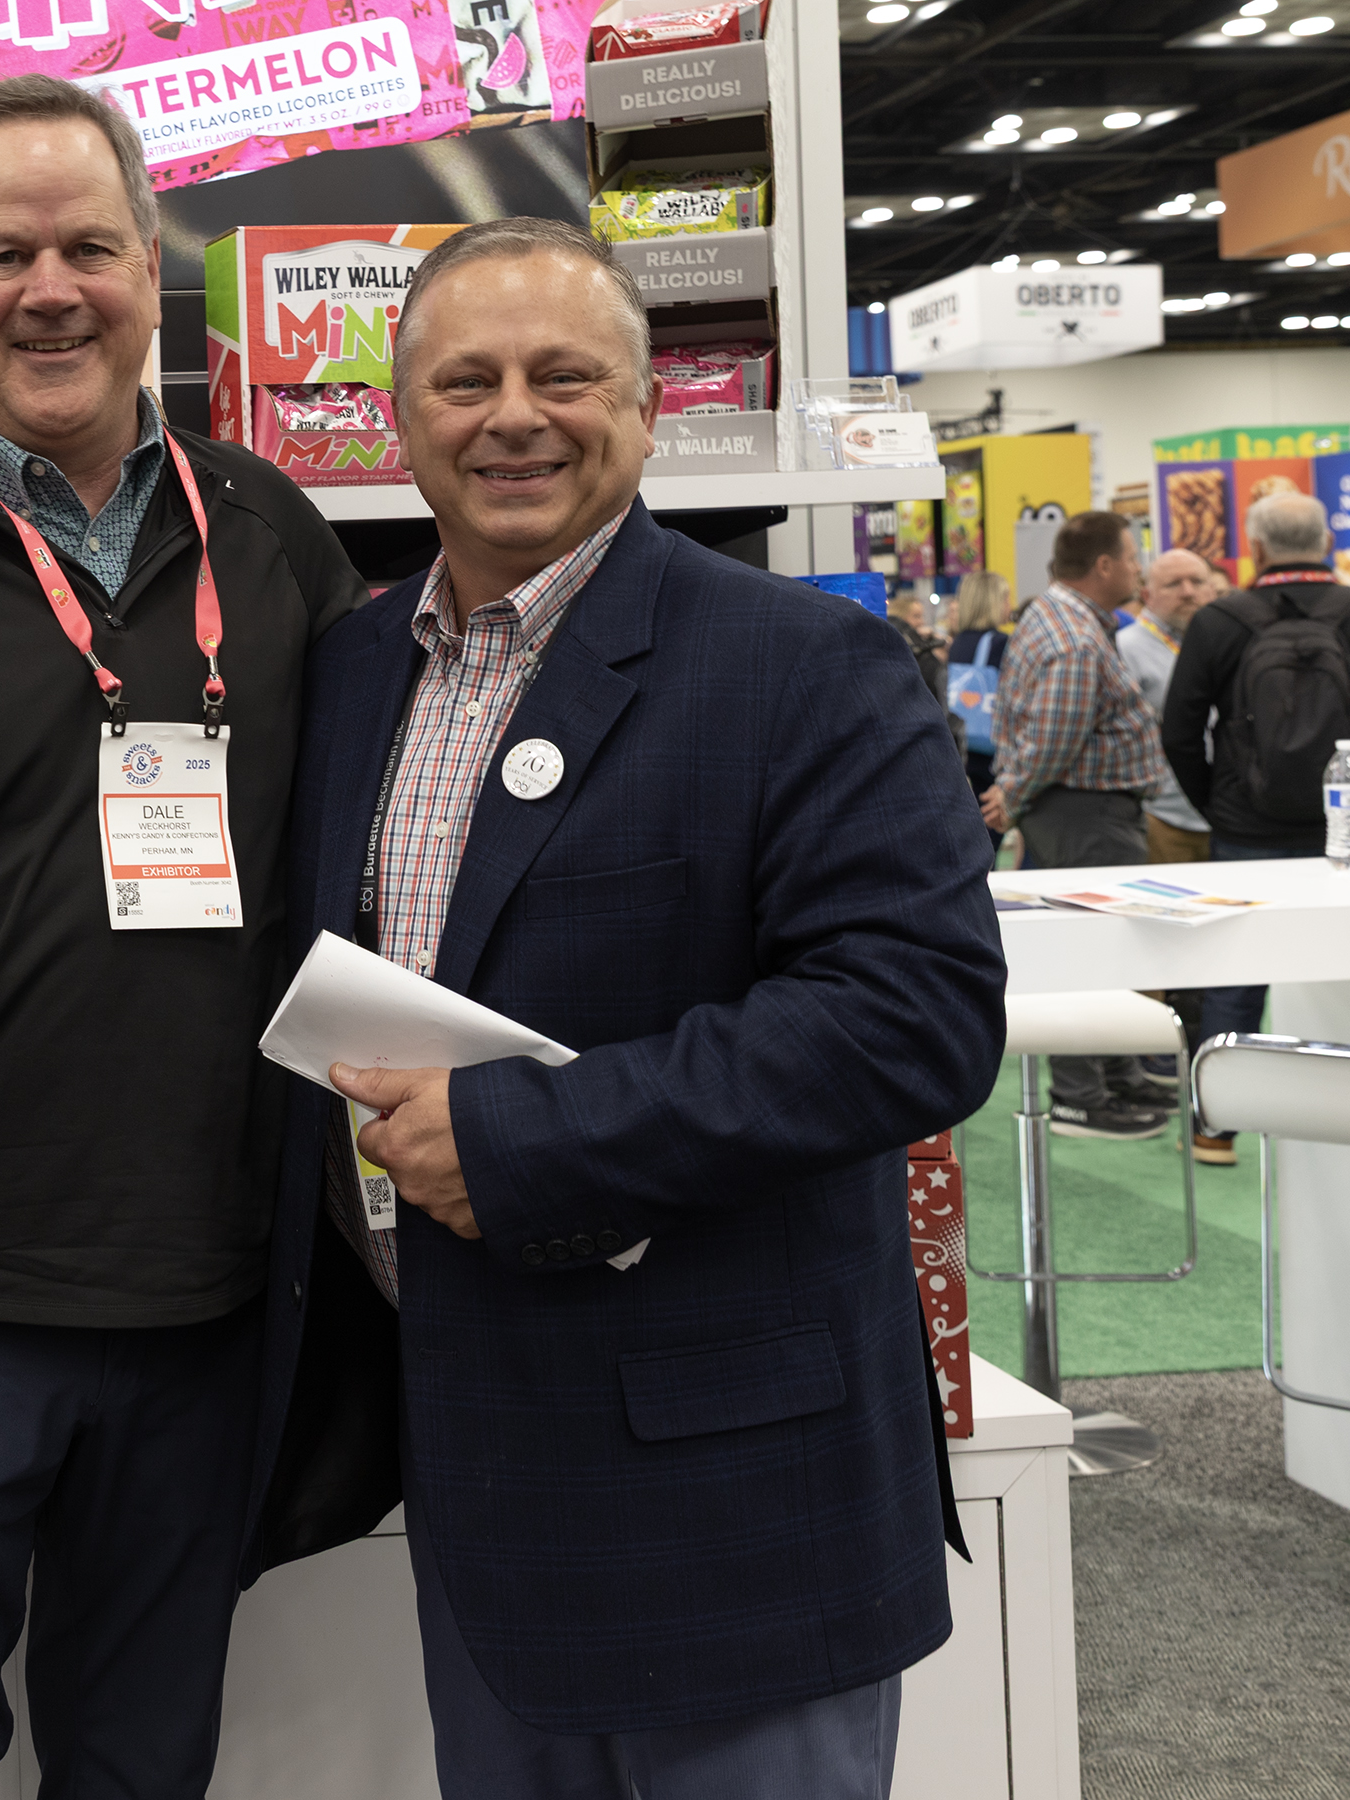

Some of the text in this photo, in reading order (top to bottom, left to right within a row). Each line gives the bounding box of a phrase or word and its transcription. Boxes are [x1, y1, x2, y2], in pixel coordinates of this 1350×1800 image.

[114, 31, 398, 121] TERMELON
[642, 59, 717, 85] REALLY
[620, 80, 742, 111] DELICIOUS!
[139, 77, 406, 142] ELON FLAVORED LICORICE BITES
[204, 127, 253, 147] FLAVORED
[284, 118, 306, 131] WT.
[364, 102, 381, 114] 99
[384, 99, 393, 110] G
[645, 248, 719, 268] REALLY
[274, 266, 341, 294] WILEY
[639, 268, 744, 291] ELICIOUS!
[331, 290, 396, 300] SOFT & CHEWY
[1017, 283, 1122, 307] OBERTO
[651, 436, 754, 459] EY WALLABY
[122, 743, 158, 764] sweets
[136, 755, 148, 771] &
[126, 764, 161, 785] snacks
[185, 759, 211, 770] 2025
[142, 805, 185, 819] DALE
[111, 832, 141, 840] KENNY'S
[141, 832, 165, 840] CANDY
[171, 831, 219, 839] CONFECTIONS
[138, 822, 192, 831] WECKHORST
[141, 847, 194, 856] PERHAM, MN
[141, 866, 202, 877] EXHIBITOR
